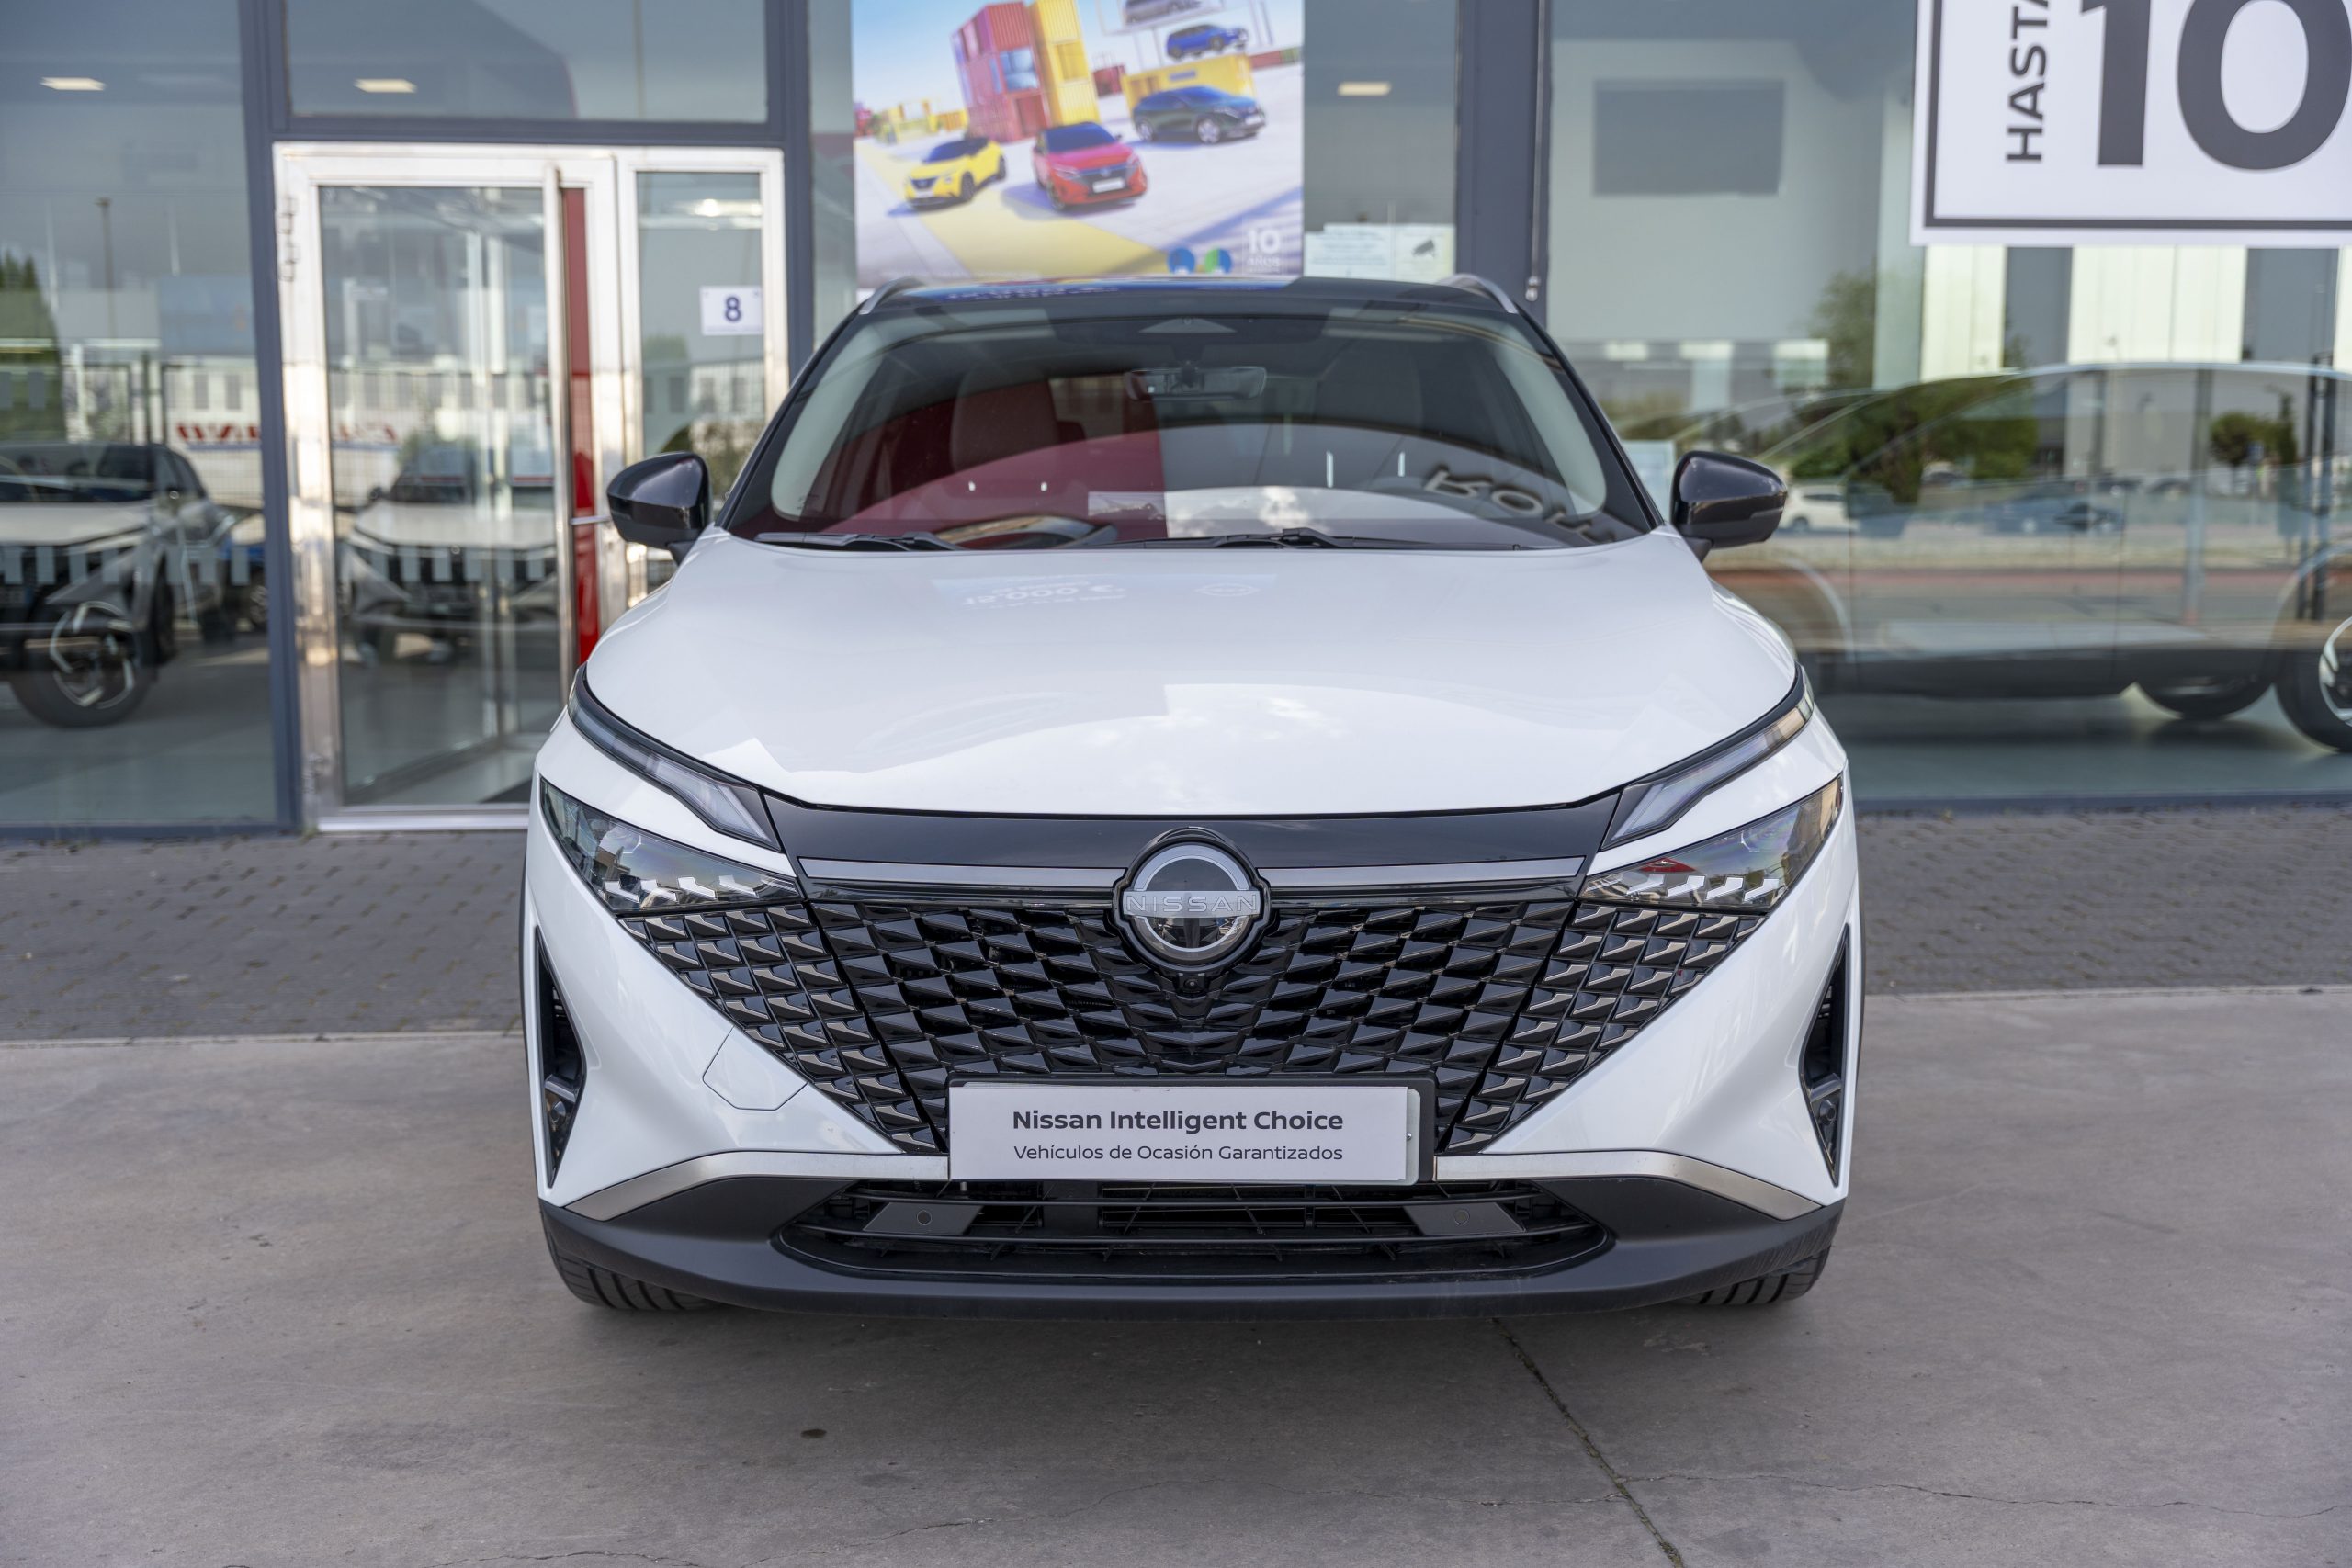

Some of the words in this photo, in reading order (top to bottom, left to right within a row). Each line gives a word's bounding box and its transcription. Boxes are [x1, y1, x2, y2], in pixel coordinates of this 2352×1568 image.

[2006, 0, 2050, 162] HAST
[2080, 0, 2352, 172] 10
[1248, 228, 1282, 254] 10
[724, 296, 741, 322] 8
[1125, 895, 1256, 912] NISSAN
[1012, 1111, 1102, 1130] Nissan
[1110, 1110, 1247, 1134] Intelligent
[1253, 1111, 1343, 1130] Choice
[1013, 1145, 1104, 1160] Vehículos
[1109, 1145, 1132, 1160] de
[1137, 1145, 1213, 1160] Ocasión
[1218, 1145, 1343, 1160] Garantizados
